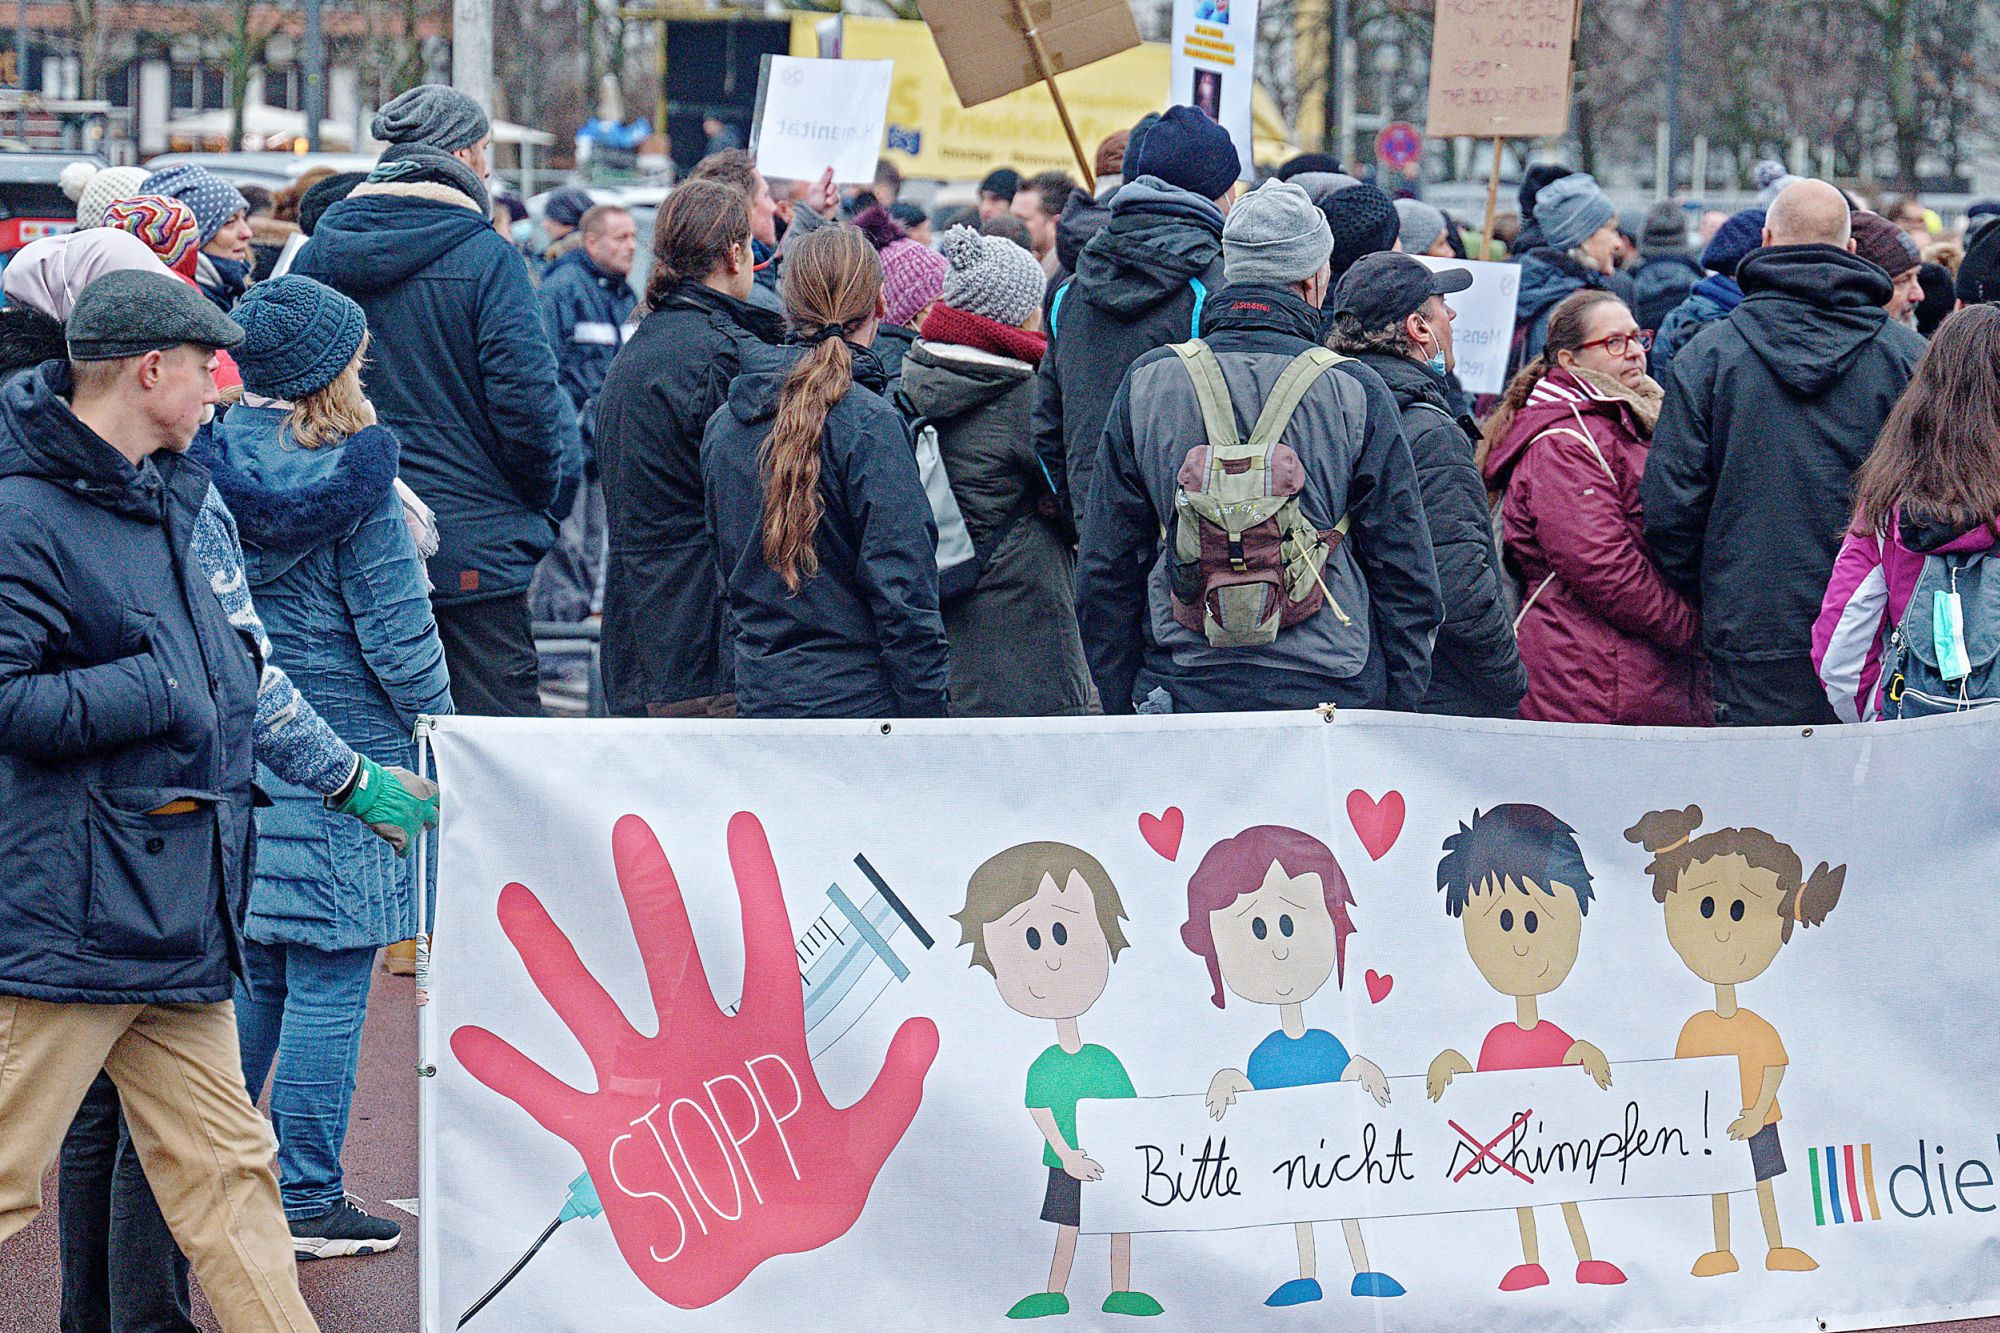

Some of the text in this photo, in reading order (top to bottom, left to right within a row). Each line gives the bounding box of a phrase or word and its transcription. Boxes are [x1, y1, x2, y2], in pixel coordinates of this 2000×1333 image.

[609, 1054, 802, 1263] STOPP
[1135, 1134, 1241, 1207] Bitte
[1273, 1123, 1414, 1191] nicht
[1889, 1134, 2000, 1219] die
